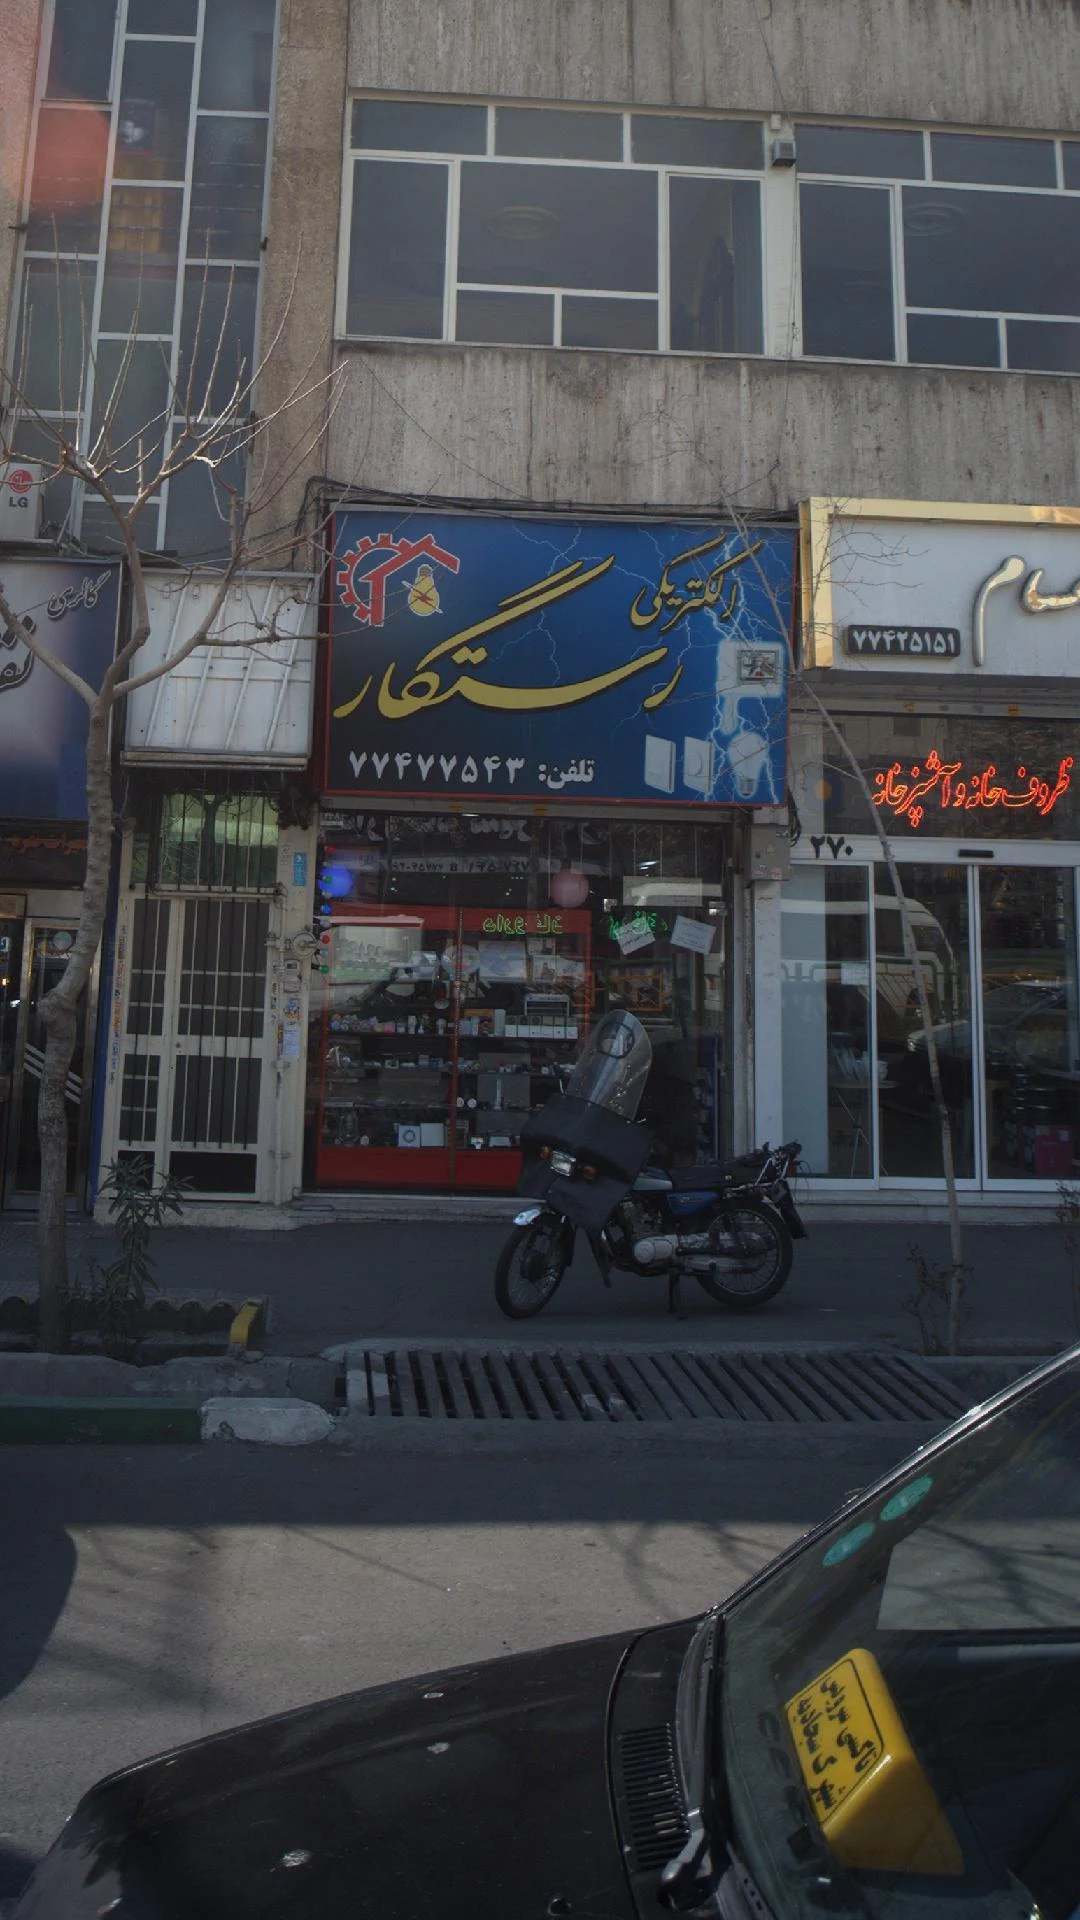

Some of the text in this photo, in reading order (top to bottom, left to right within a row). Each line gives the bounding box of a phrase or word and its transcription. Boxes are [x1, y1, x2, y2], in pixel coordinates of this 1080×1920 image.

[9, 496, 28, 508] LG
[630, 532, 765, 632] الکتریکی
[333, 555, 684, 720] رستگار
[852, 629, 955, 654] ۷۷۴۲۵۱۵۱
[349, 751, 596, 789] تلفن: ۷۷۴۷۷۵۴۳
[1002, 755, 1075, 816] ظروف
[810, 835, 853, 859] ۲۷۰
